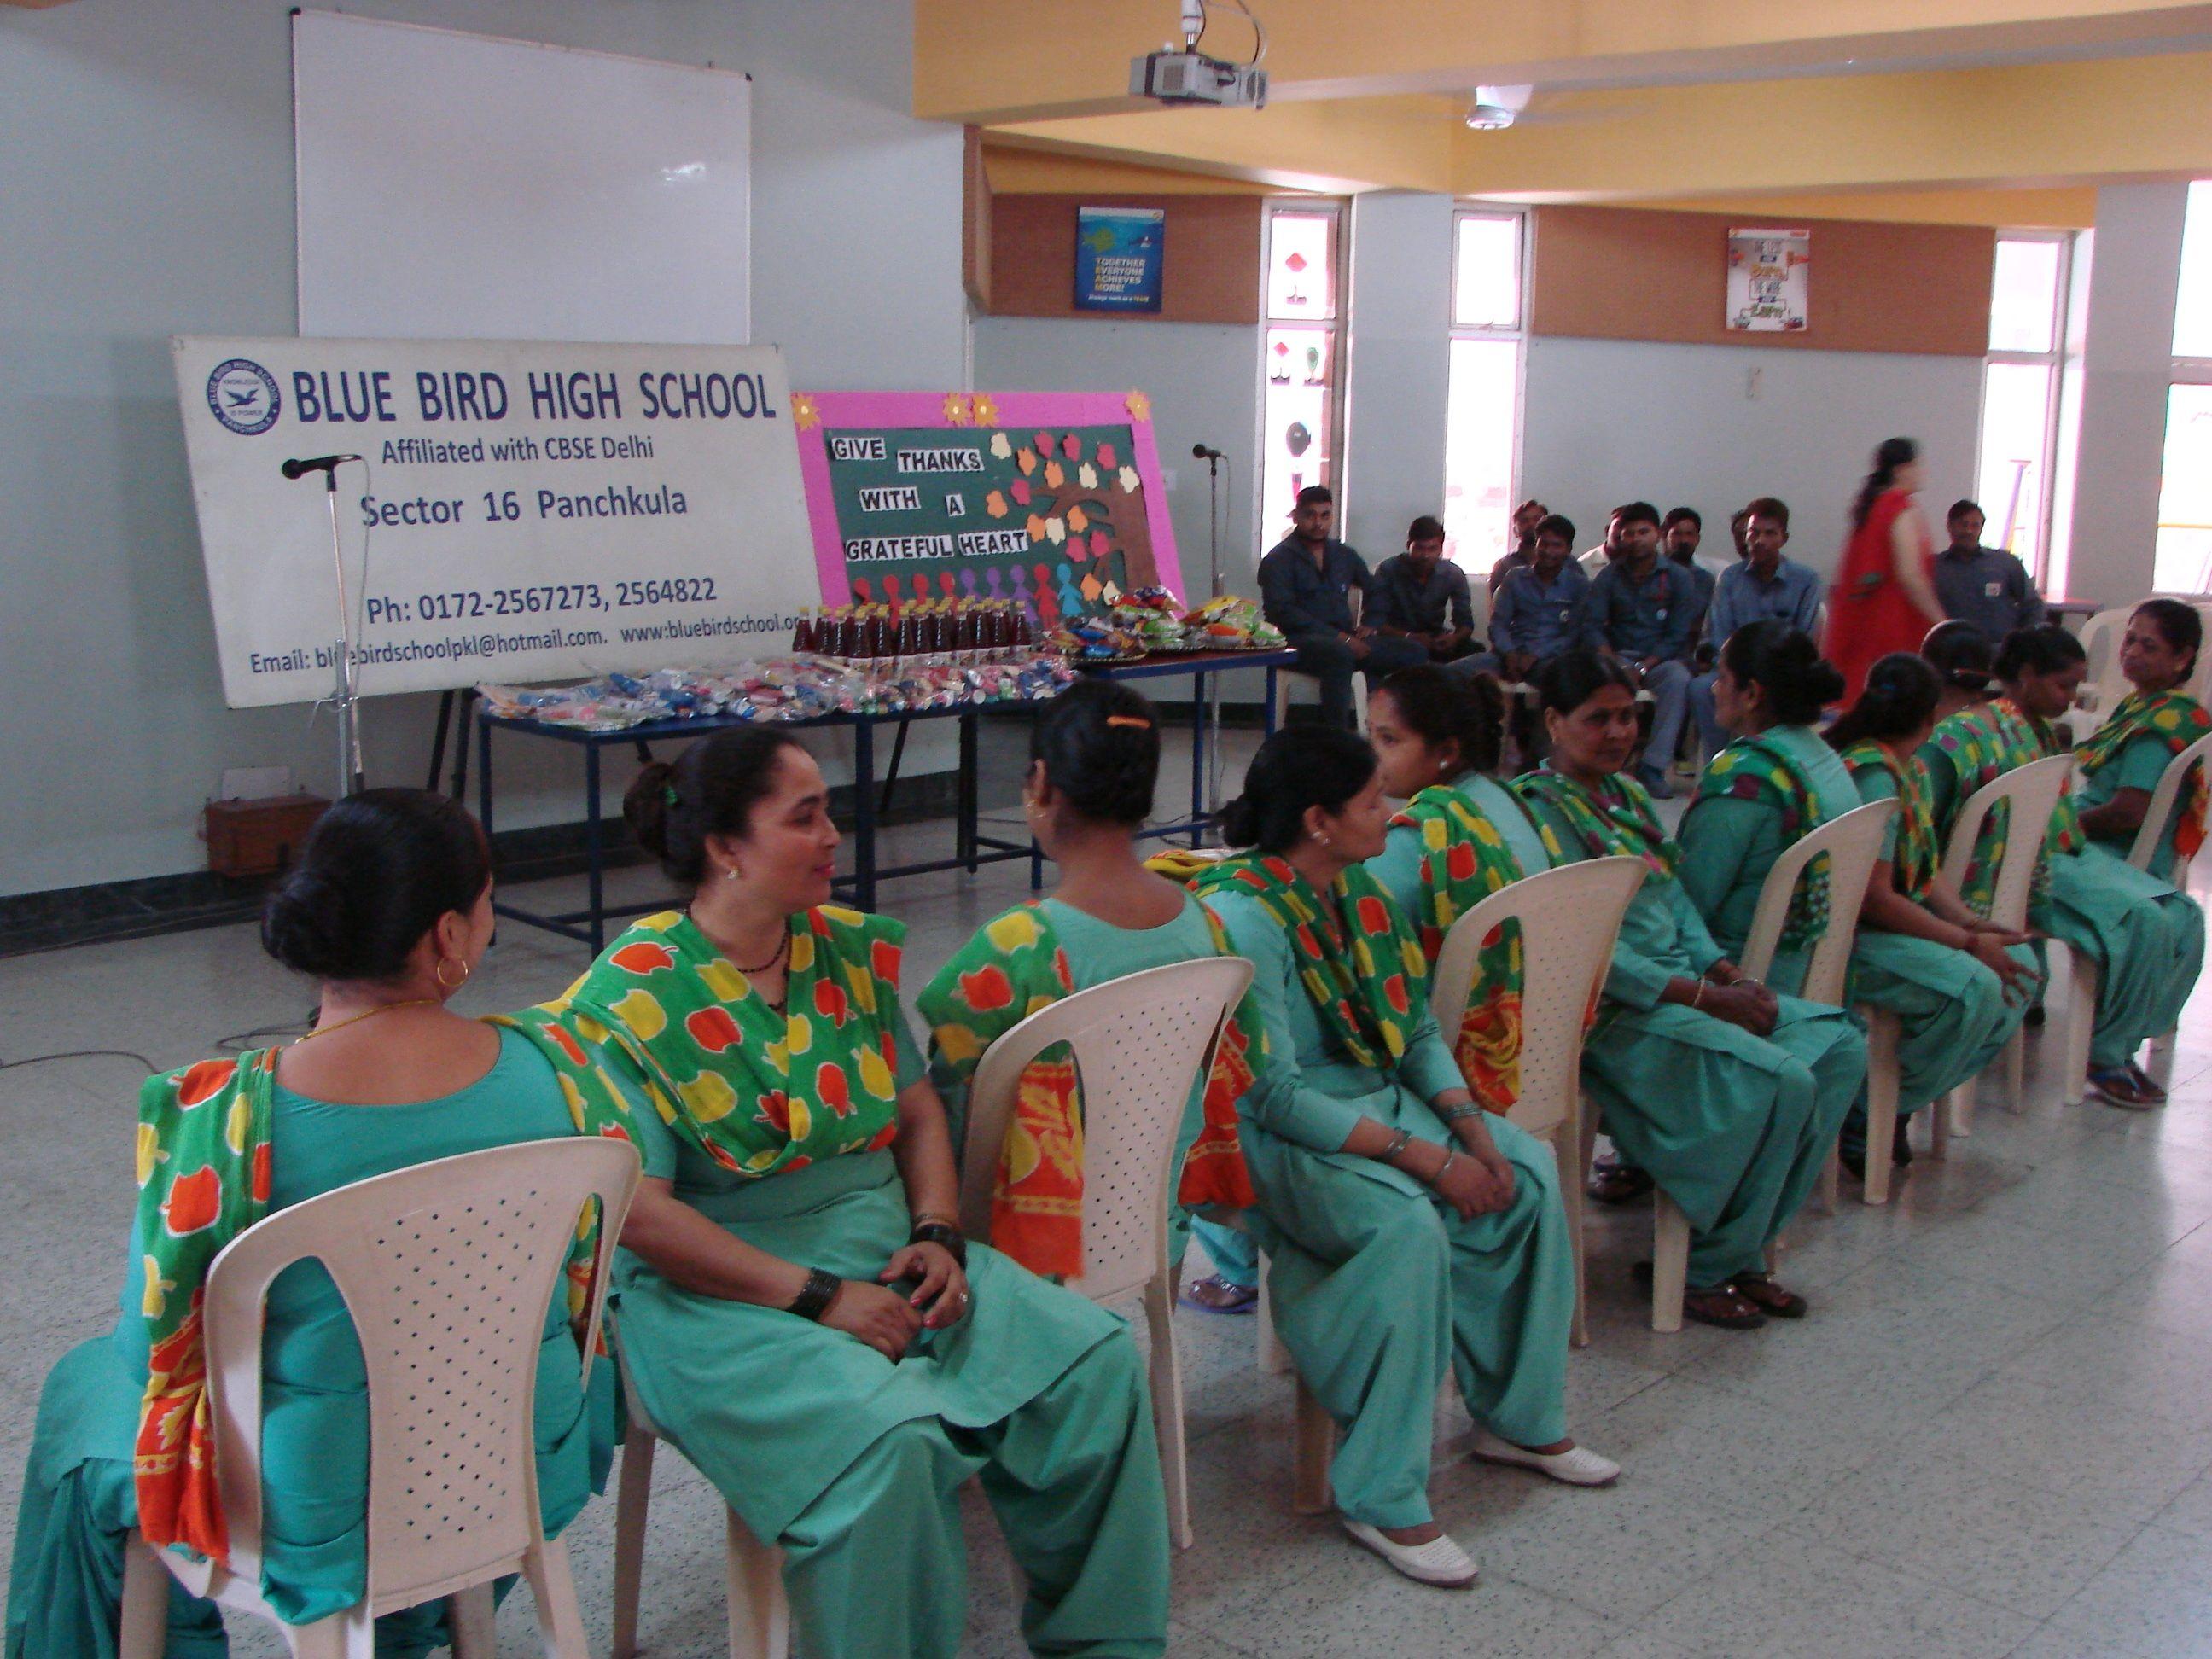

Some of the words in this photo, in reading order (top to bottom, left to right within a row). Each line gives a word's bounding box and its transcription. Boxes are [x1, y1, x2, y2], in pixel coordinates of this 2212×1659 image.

[1095, 266, 1144, 276] EVERYONE
[1096, 258, 1145, 267] TOGETHER
[1095, 275, 1142, 284] ACHIEVES
[293, 371, 396, 422] BLUE
[416, 372, 508, 421] BIRD
[528, 372, 621, 419] HIGH
[640, 372, 777, 419] SCHOOL
[382, 438, 484, 464] Affiliated
[490, 436, 539, 462] with
[545, 437, 596, 460] CBSE
[602, 435, 654, 459] Delhi
[834, 439, 883, 459] GIVE
[899, 451, 981, 470] THANKS
[360, 495, 463, 527] Sector
[483, 491, 521, 521] 16
[538, 484, 688, 519] Panchkula
[861, 489, 918, 509] WITH
[949, 496, 962, 515] A
[847, 538, 953, 560] GRATEFUL
[960, 533, 1025, 555] HEART
[367, 596, 411, 624] Ph:
[419, 584, 609, 620] 0172-2567273,
[615, 577, 718, 606] 2564822
[250, 650, 310, 673] Email:
[315, 630, 607, 667] blebirdschoolpkl@hotmail.com.
